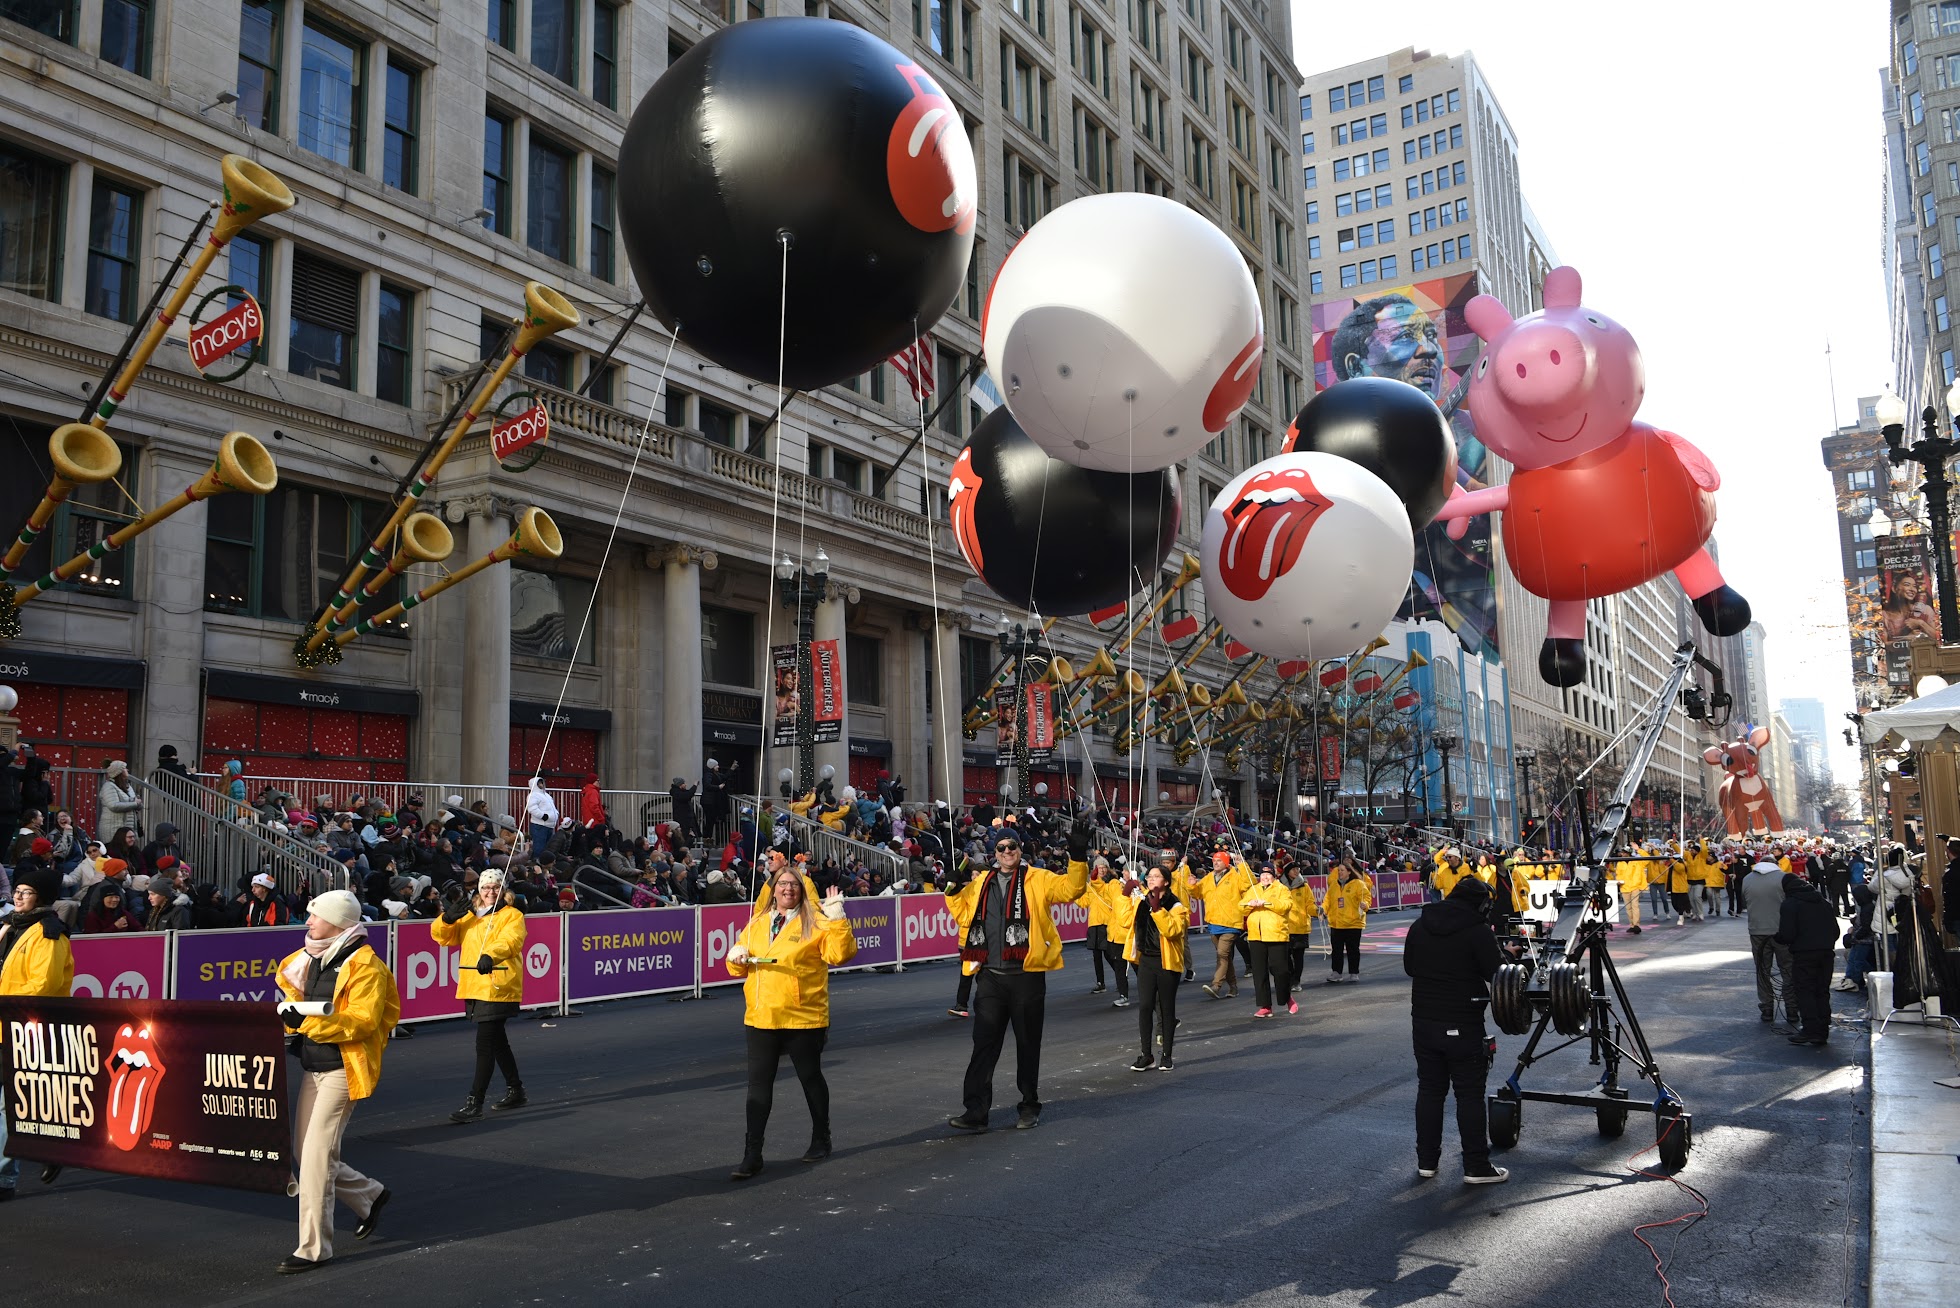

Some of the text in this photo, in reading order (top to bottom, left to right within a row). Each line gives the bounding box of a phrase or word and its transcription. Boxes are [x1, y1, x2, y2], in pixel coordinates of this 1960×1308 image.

[192, 304, 258, 361] macy's
[493, 406, 546, 451] macy's
[0, 661, 28, 677] acy's
[818, 648, 833, 715] NUTCRACKER
[309, 692, 339, 704] macy's
[732, 697, 758, 710] FIELD
[711, 704, 752, 719] COMPANY
[1033, 686, 1046, 743] NUTCRACKER
[865, 916, 888, 928] NOW
[905, 908, 958, 947] pluto
[582, 930, 684, 951] STREAM NOW
[856, 936, 881, 950] EVER
[200, 959, 279, 981] STREA
[530, 951, 548, 969] tv
[595, 955, 673, 976] PAY NEVER
[10, 1021, 99, 1075] ROLLING
[204, 1053, 275, 1090] JUNE 27
[14, 1071, 94, 1127] STONES
[202, 1094, 277, 1119] SOLDIER FIELD
[16, 1121, 80, 1139] HACKNEY DIAMONDS TOUR
[150, 1139, 172, 1149] AARP
[250, 1149, 263, 1158] AEG
